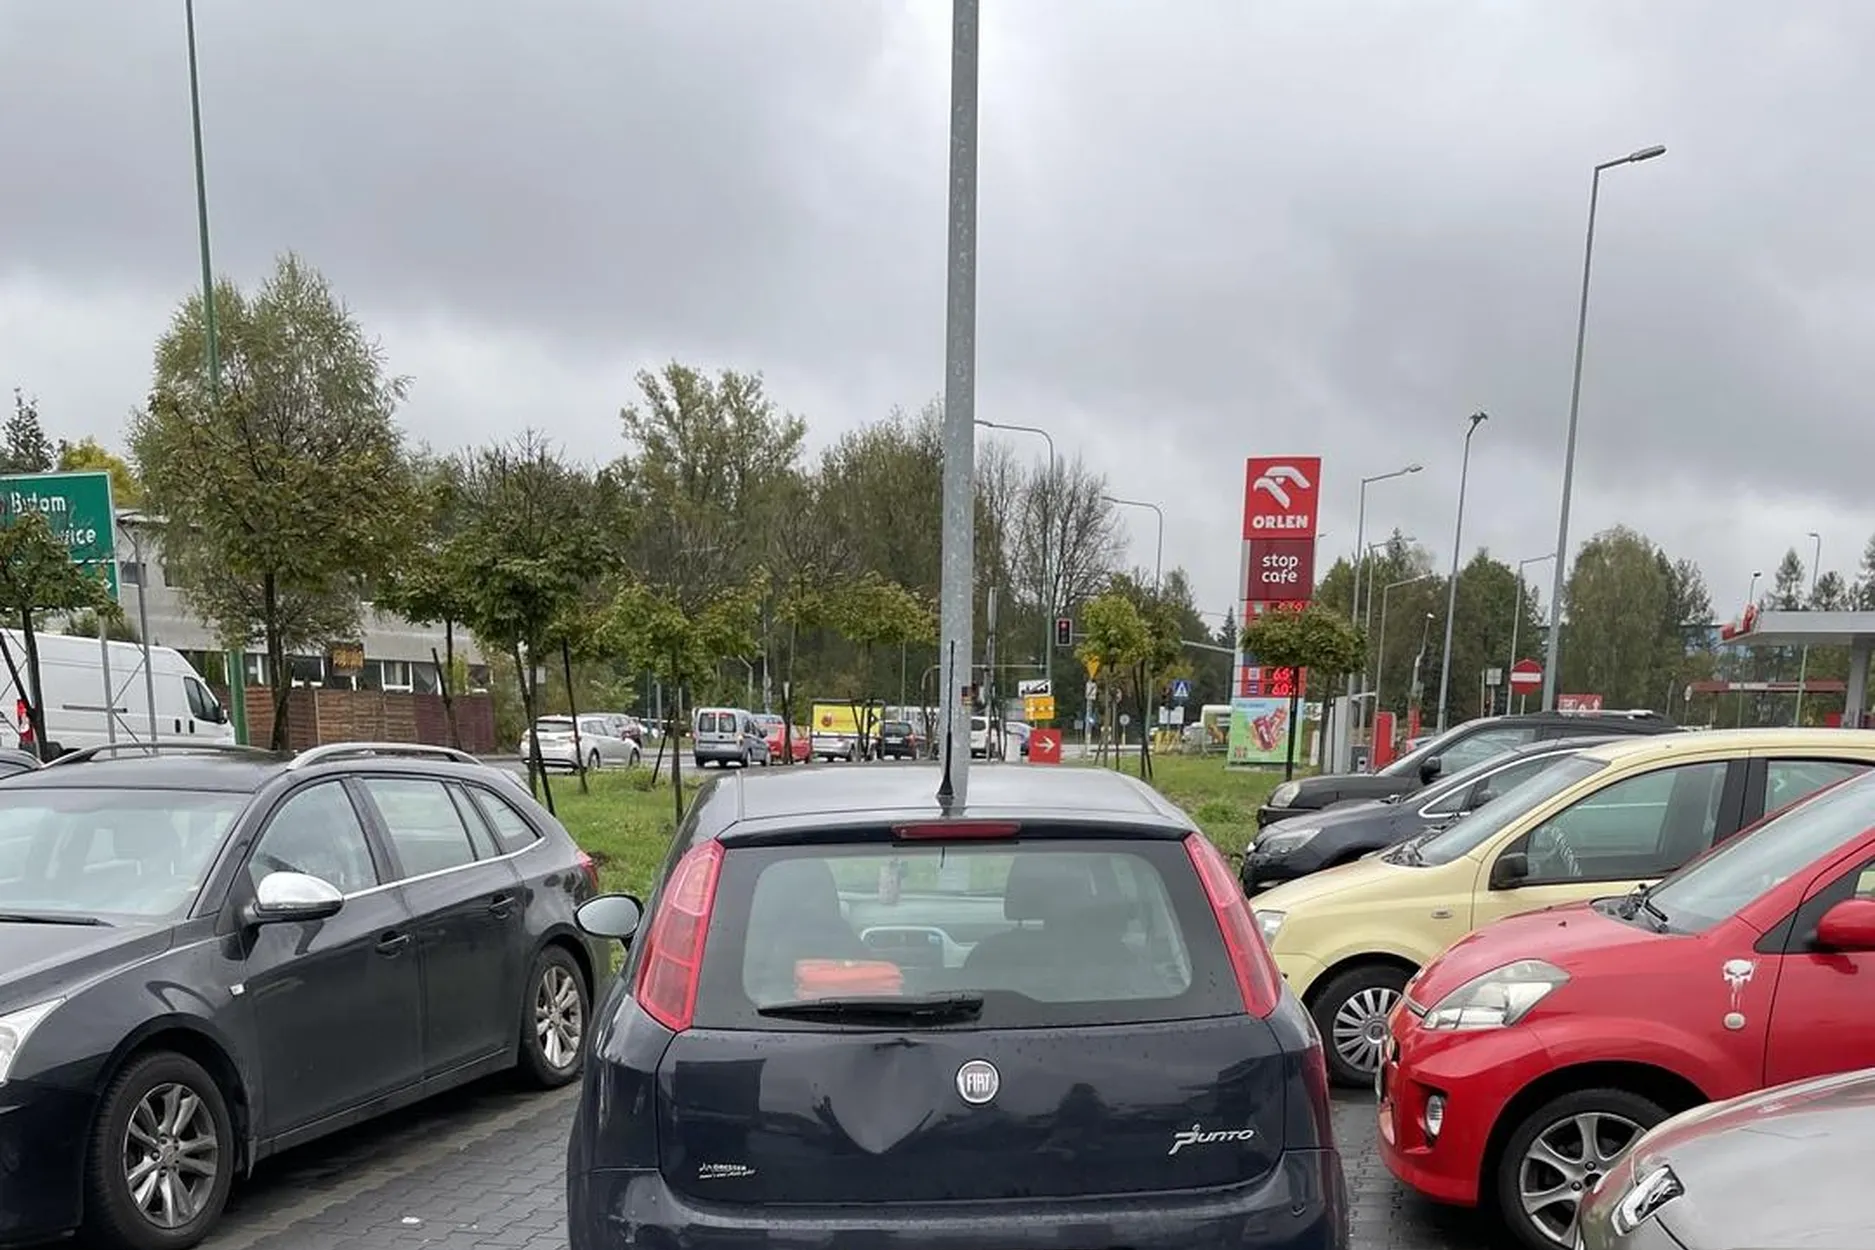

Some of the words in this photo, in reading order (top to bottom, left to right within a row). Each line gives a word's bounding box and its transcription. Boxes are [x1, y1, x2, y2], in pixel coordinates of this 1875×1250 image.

[1252, 514, 1309, 529] ORLEN
[1262, 553, 1299, 571] stop
[1261, 569, 1298, 584] cafe
[966, 1072, 990, 1093] FIAT
